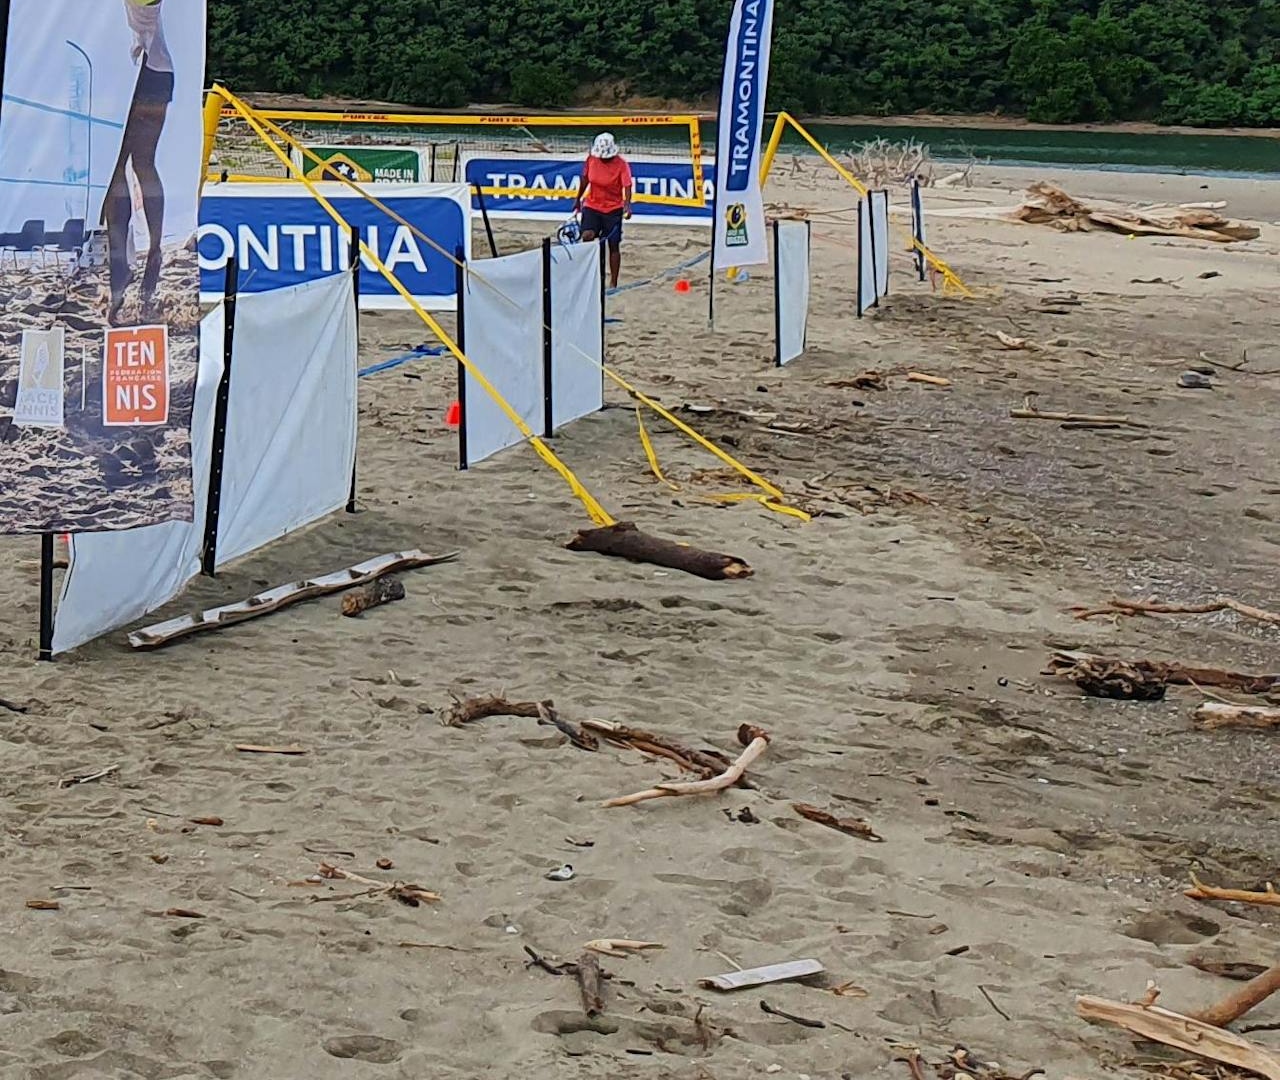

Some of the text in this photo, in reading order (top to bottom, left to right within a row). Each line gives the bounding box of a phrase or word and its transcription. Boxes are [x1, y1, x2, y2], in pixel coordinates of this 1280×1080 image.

[731, 0, 761, 177] TRAMONTINA
[375, 168, 414, 179] MADE IN
[486, 173, 714, 201] TRAMTINA
[197, 223, 428, 273] ONTINA
[114, 341, 155, 367] TEN
[115, 385, 157, 411] NIS
